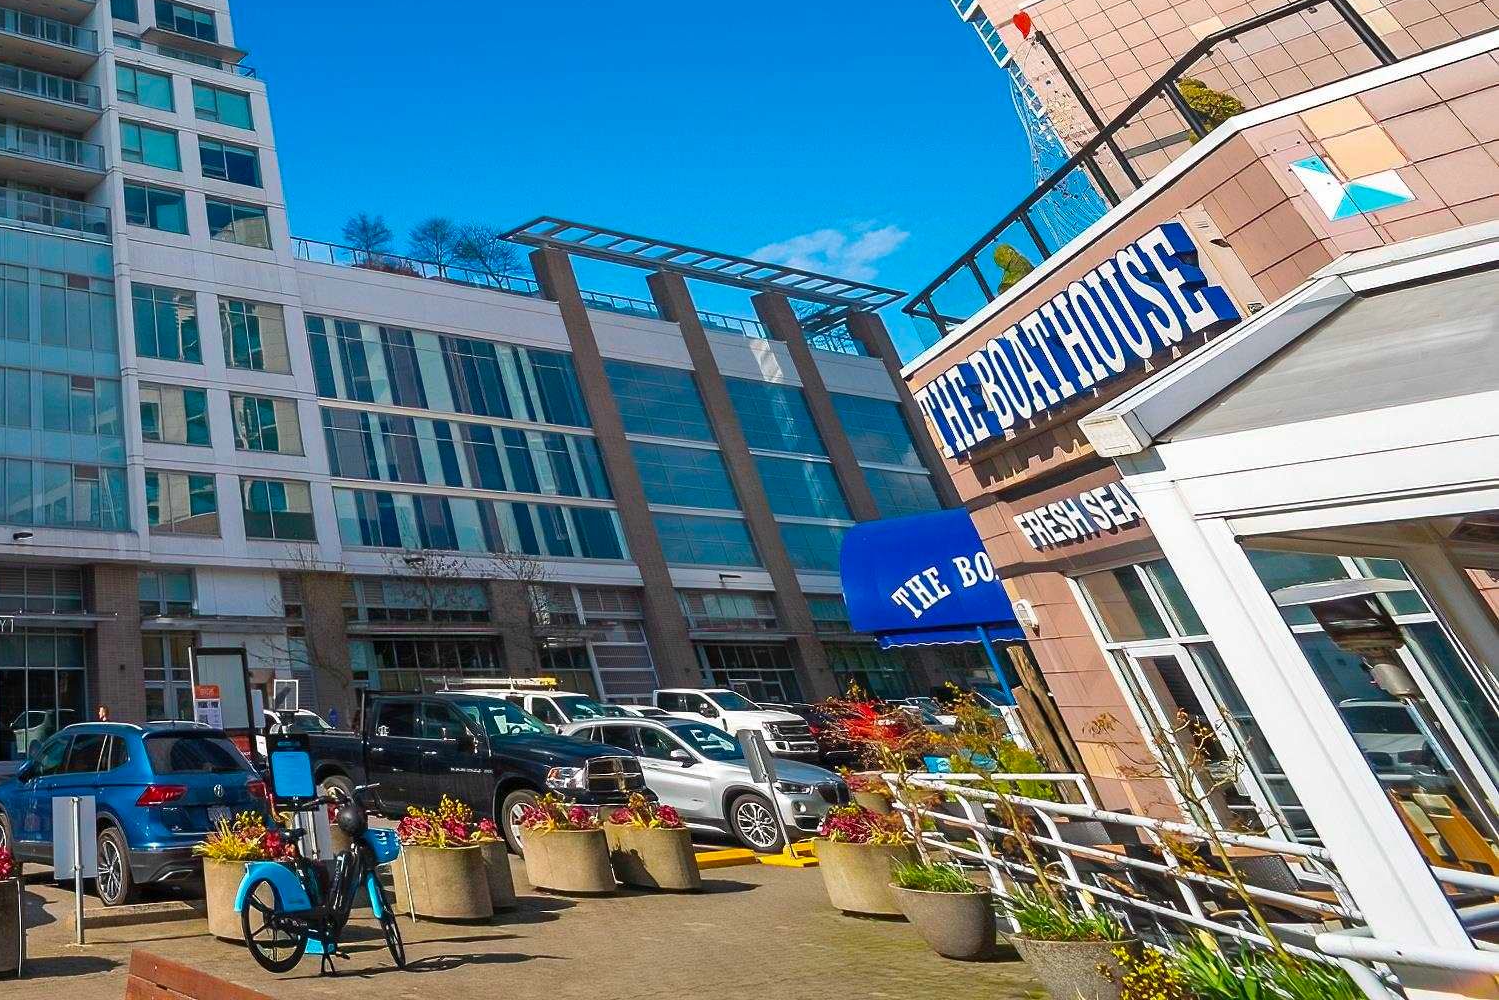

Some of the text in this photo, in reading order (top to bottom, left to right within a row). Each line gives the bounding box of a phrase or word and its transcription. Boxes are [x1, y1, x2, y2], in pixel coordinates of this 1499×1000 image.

[914, 225, 1219, 459] THE BOATHOUSE
[1012, 479, 1143, 549] FRESH SEA
[890, 551, 1000, 619] THE BO
[9, 618, 15, 633] 1
